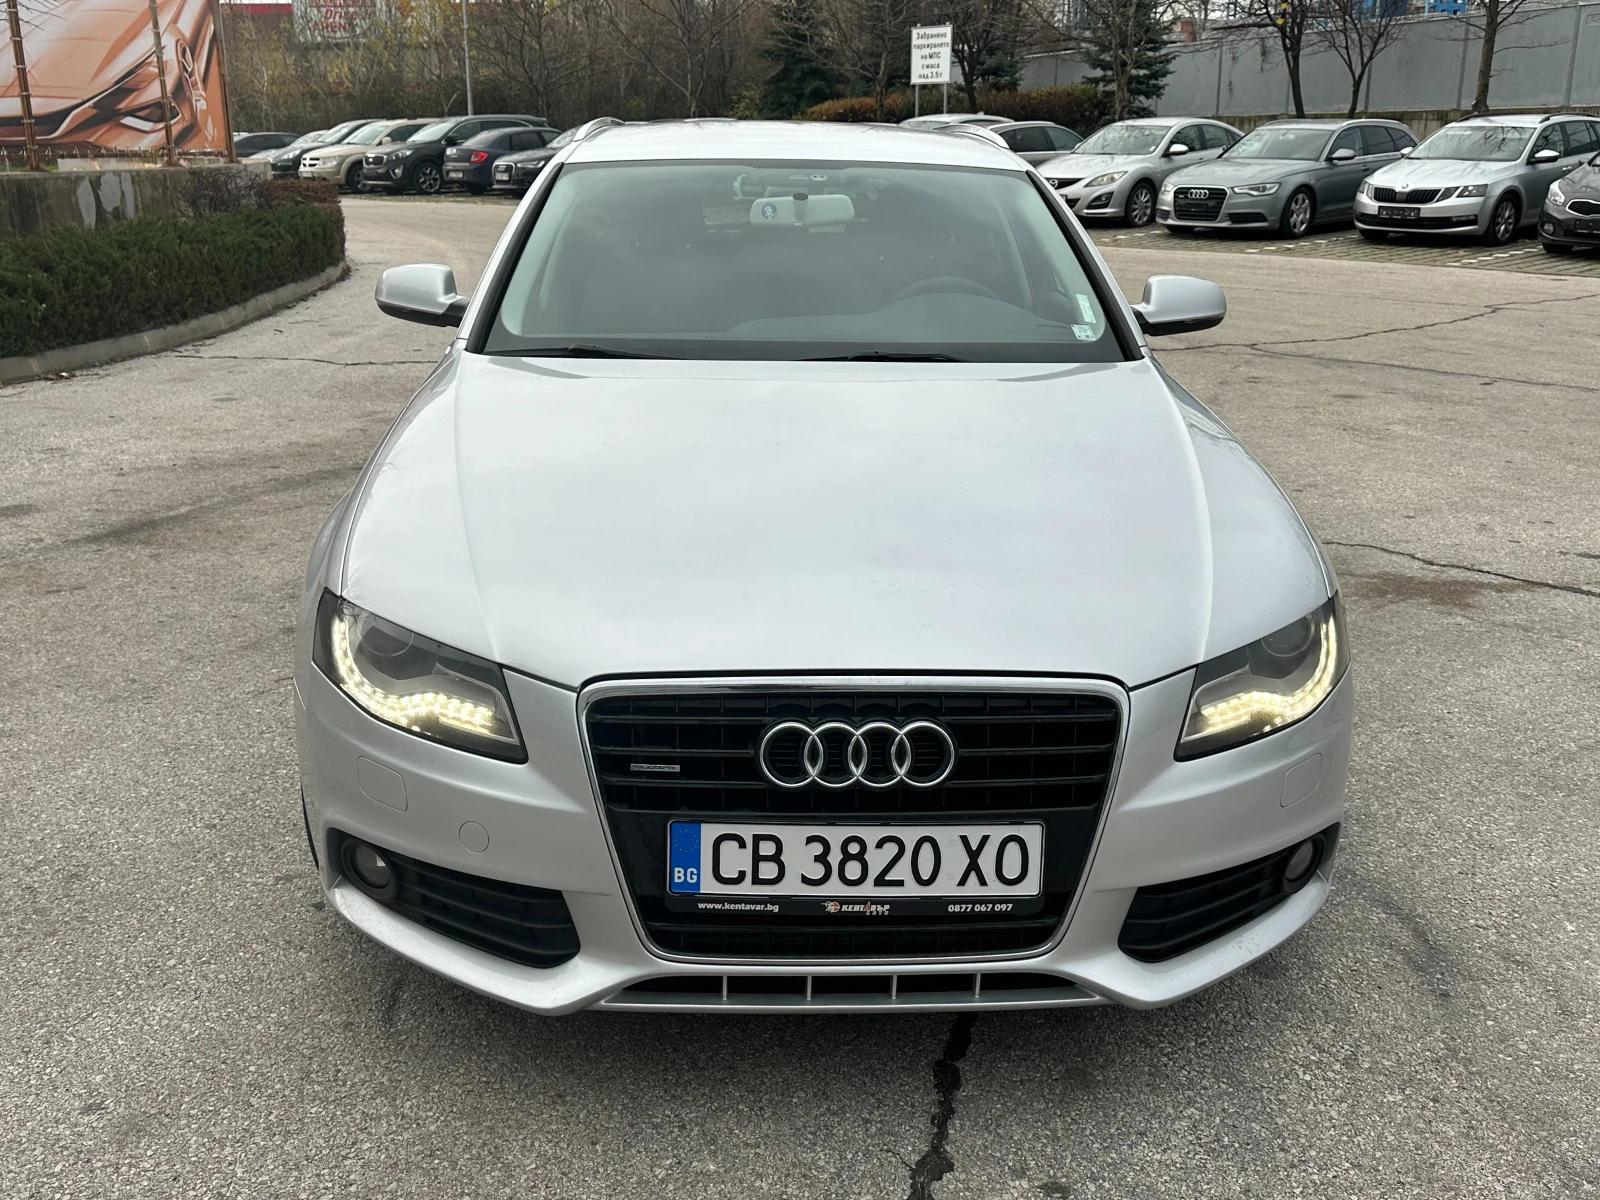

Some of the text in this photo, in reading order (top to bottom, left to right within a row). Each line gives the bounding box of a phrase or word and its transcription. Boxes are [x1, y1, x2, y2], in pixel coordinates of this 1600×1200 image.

[915, 32, 947, 40] Забранено
[913, 42, 950, 50] паркирането
[928, 51, 942, 59] МПС
[918, 72, 930, 80] над
[712, 832, 1029, 887] CB 3820 XO
[674, 867, 698, 883] BG
[697, 902, 780, 913] www.kentavar.bg
[947, 903, 1013, 912] 0877 067 097
